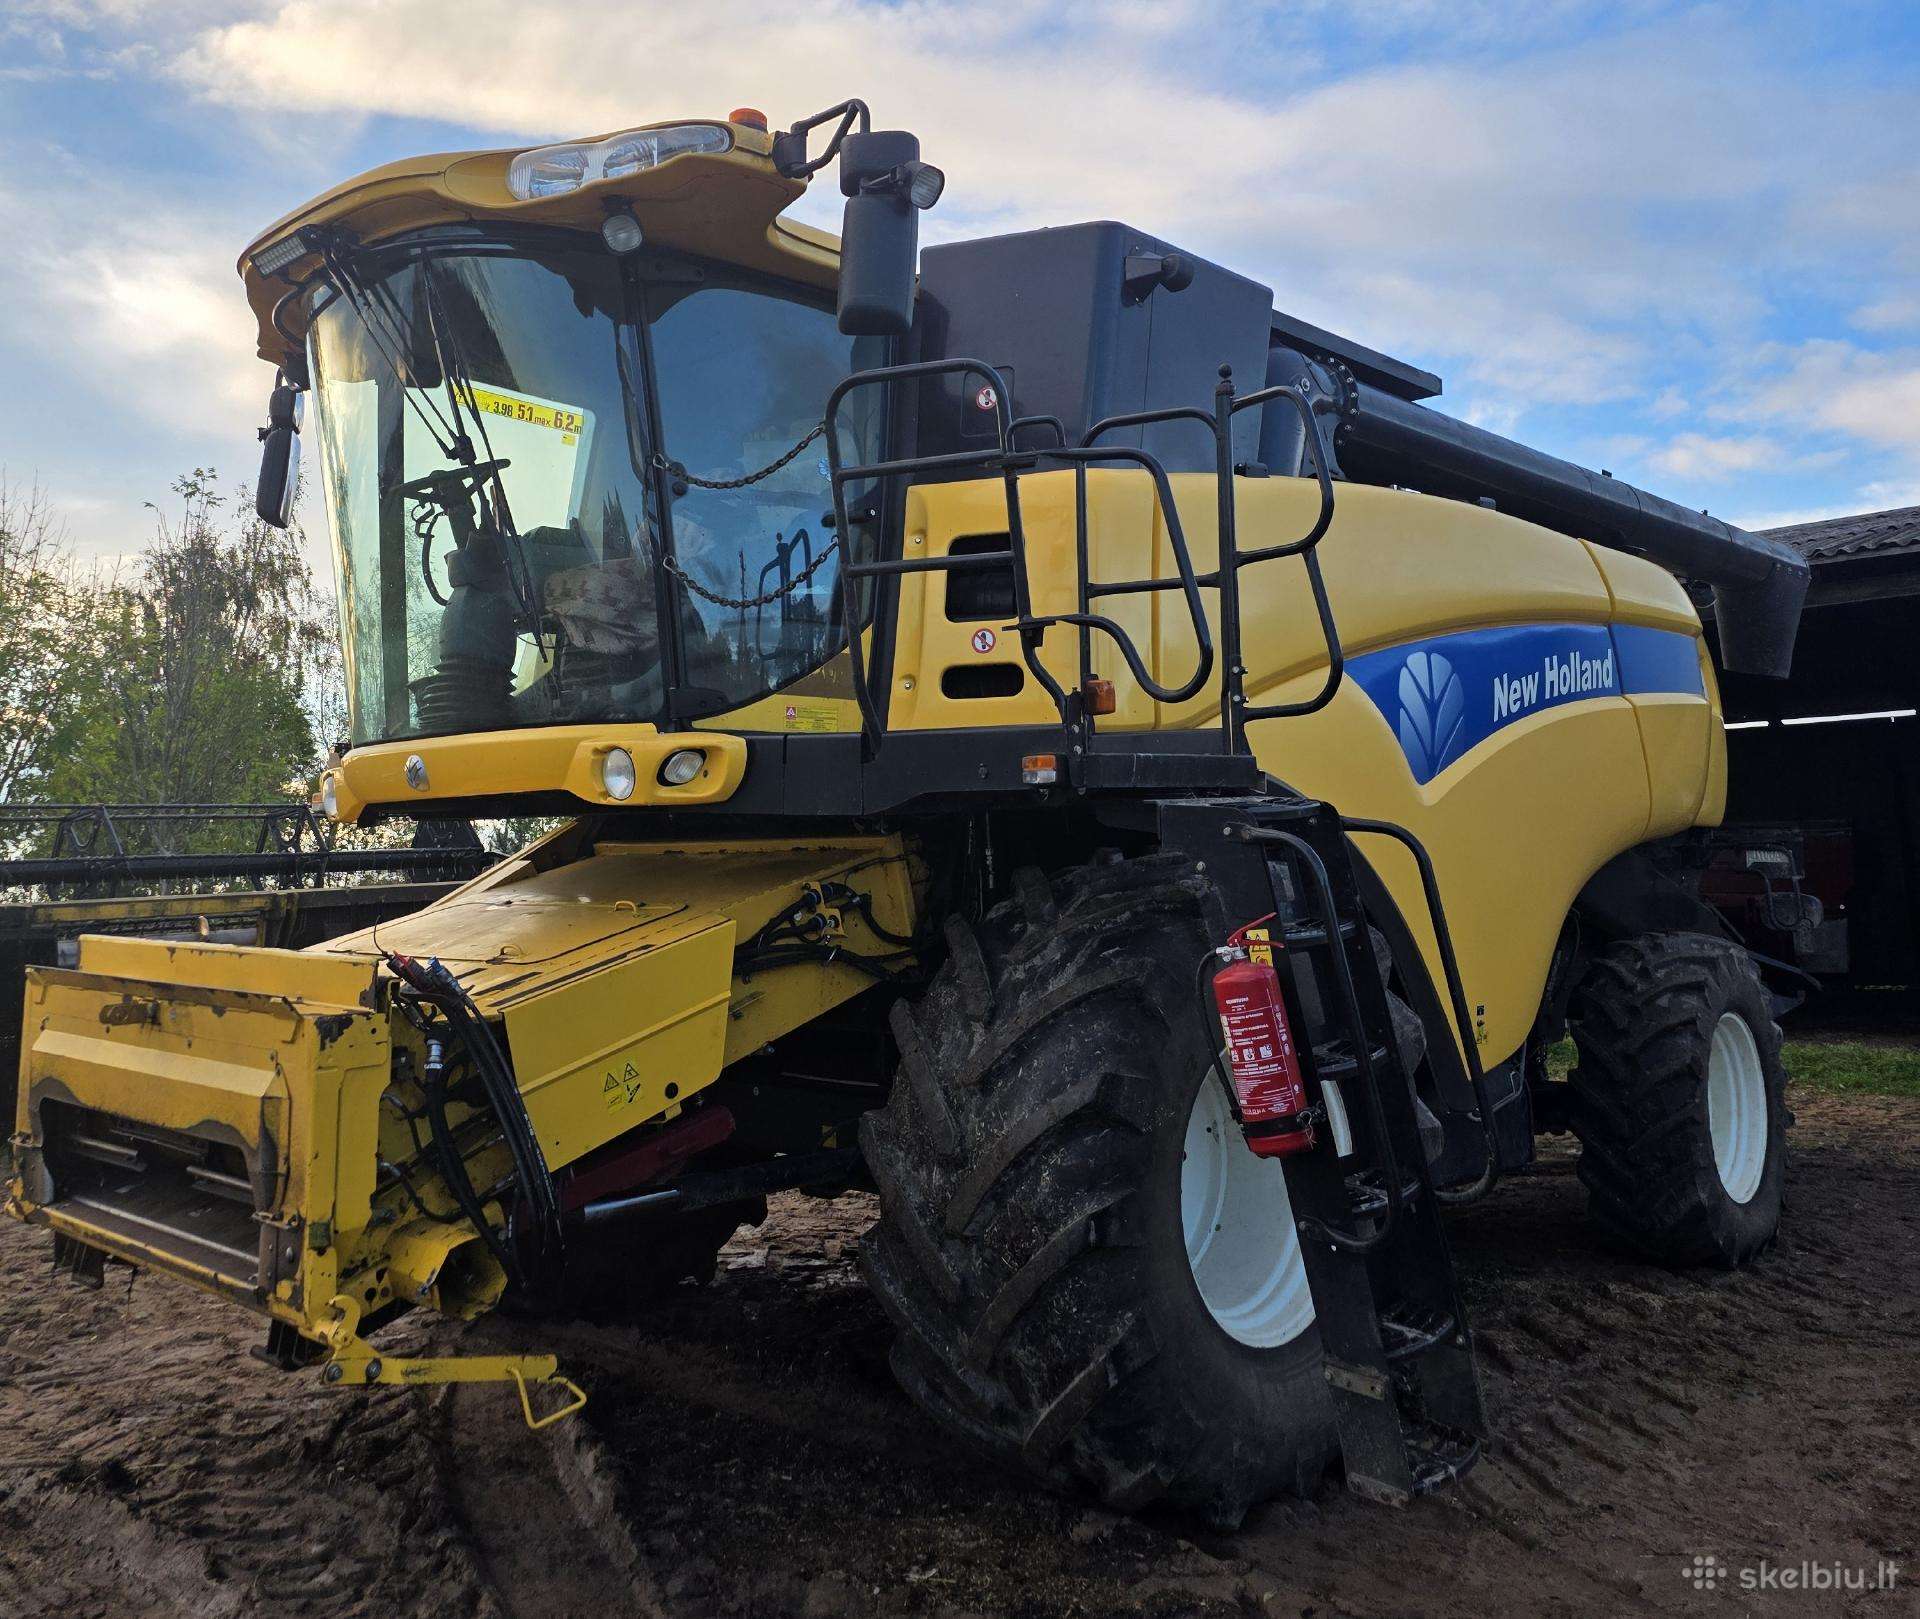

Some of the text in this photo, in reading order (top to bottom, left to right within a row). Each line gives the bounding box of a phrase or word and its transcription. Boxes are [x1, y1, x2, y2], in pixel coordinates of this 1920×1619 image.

[493, 401, 514, 417] 3.98
[517, 403, 534, 422] 5.1
[534, 415, 551, 426] max
[1493, 648, 1613, 722] New Holland
